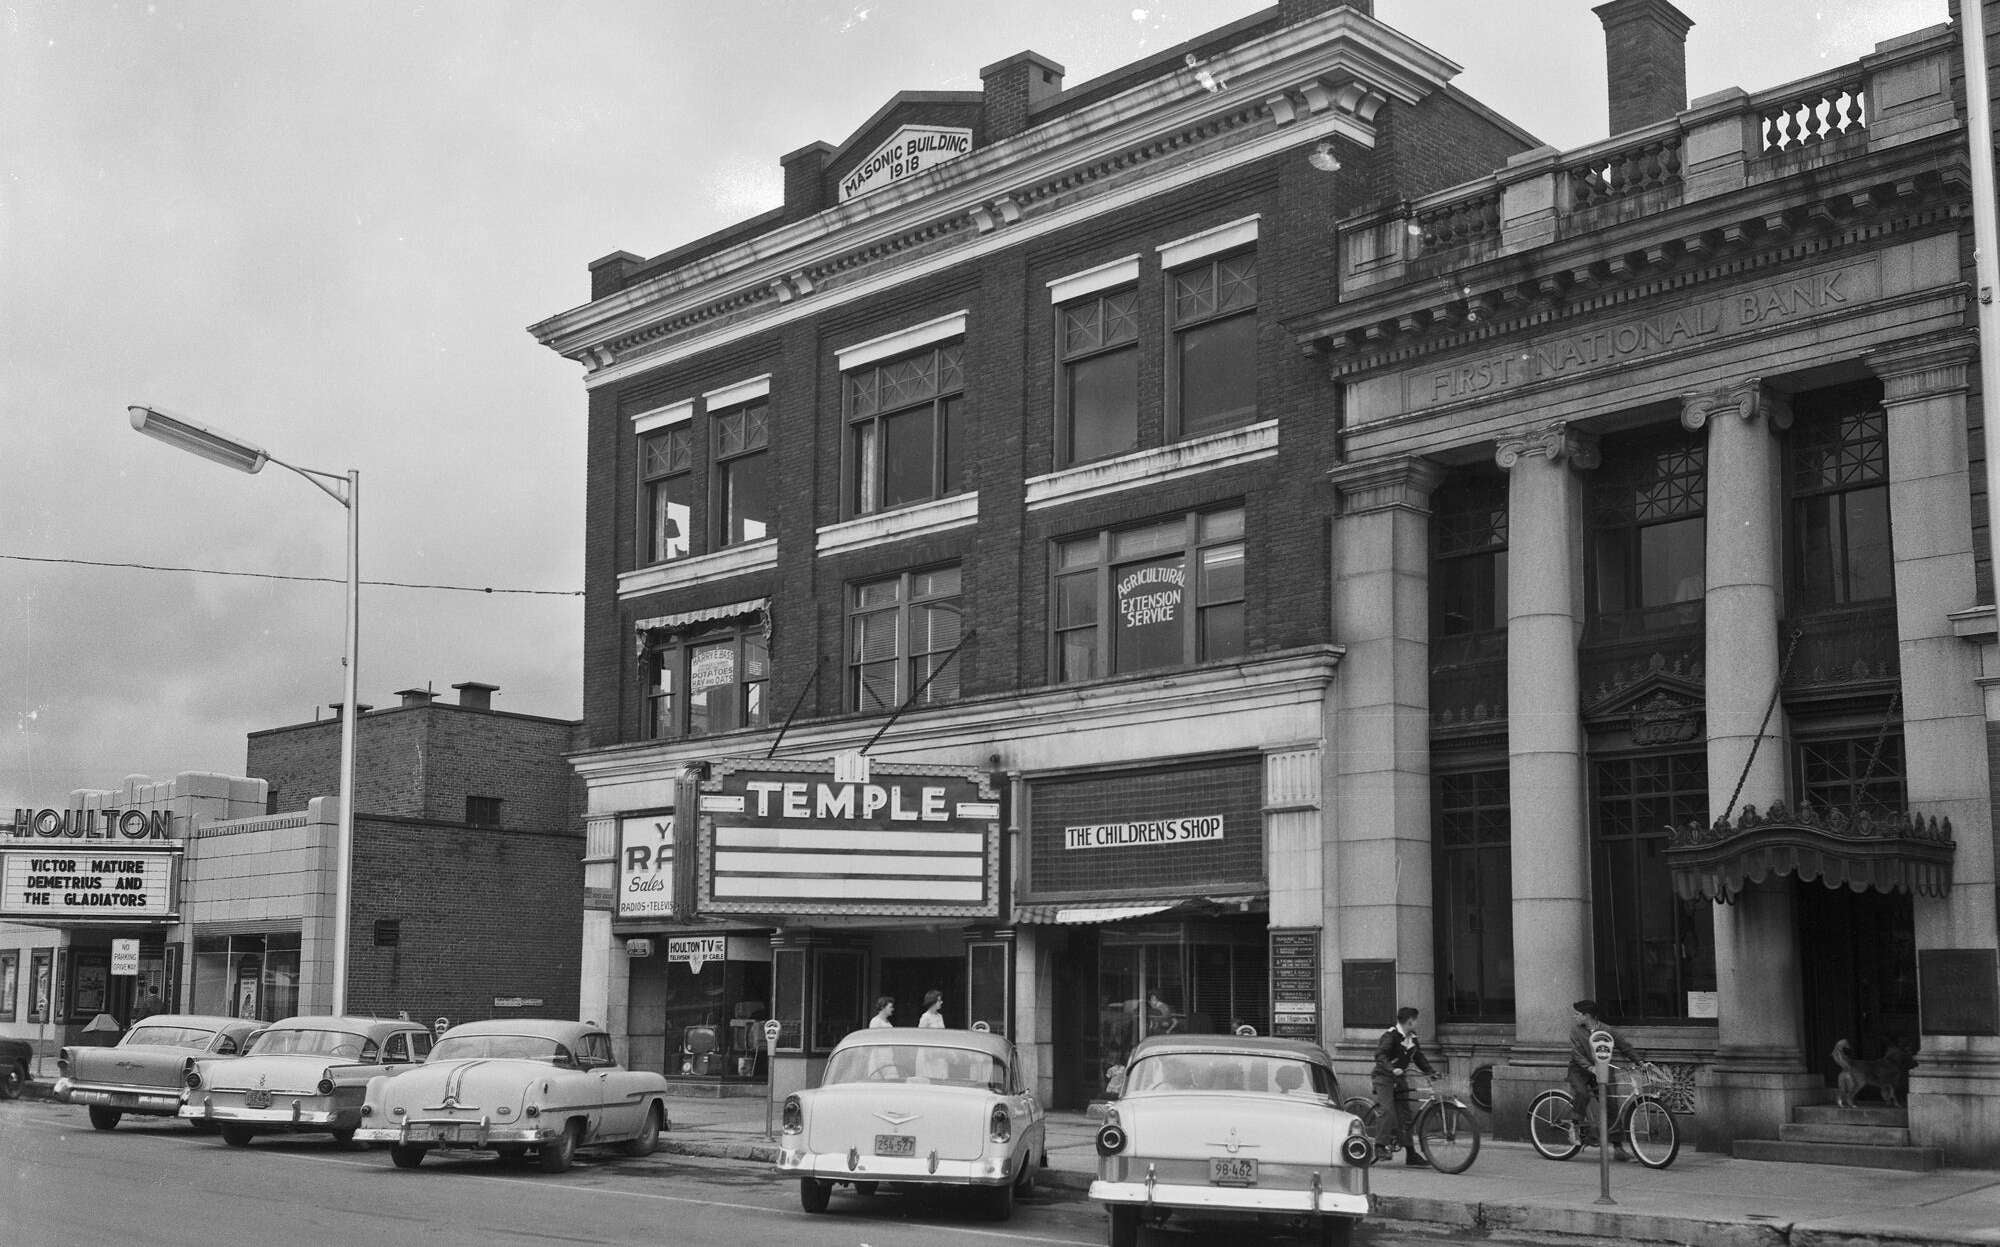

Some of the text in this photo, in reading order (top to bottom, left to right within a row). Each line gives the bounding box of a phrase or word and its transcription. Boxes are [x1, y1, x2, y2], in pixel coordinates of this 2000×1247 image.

[845, 145, 903, 198] MASONIC
[890, 155, 920, 180] 1918
[1431, 272, 1848, 402] FIRST NATIONAL BANK
[1117, 567, 1185, 599] AGRICULTURAL
[1121, 589, 1181, 614] EXTENSION
[1126, 605, 1174, 628] SERVICE
[692, 667, 733, 679] POTATOES
[692, 678, 705, 688] HAY
[715, 675, 733, 685] OATS
[746, 780, 950, 822] TEMPLE
[14, 808, 173, 840] HOULTON
[1067, 816, 1220, 848] THE CHILDREN'S SHOP
[31, 858, 144, 874] VICTOR MATURE
[27, 875, 143, 890] DEMETRIUS AND
[629, 873, 665, 893] Sales
[24, 892, 147, 907] THE GLADIATORS
[620, 901, 646, 912] RADIOS
[121, 943, 130, 951] NO
[670, 941, 700, 953] HOULTON
[701, 939, 714, 952] TV
[114, 953, 137, 961] PARKING
